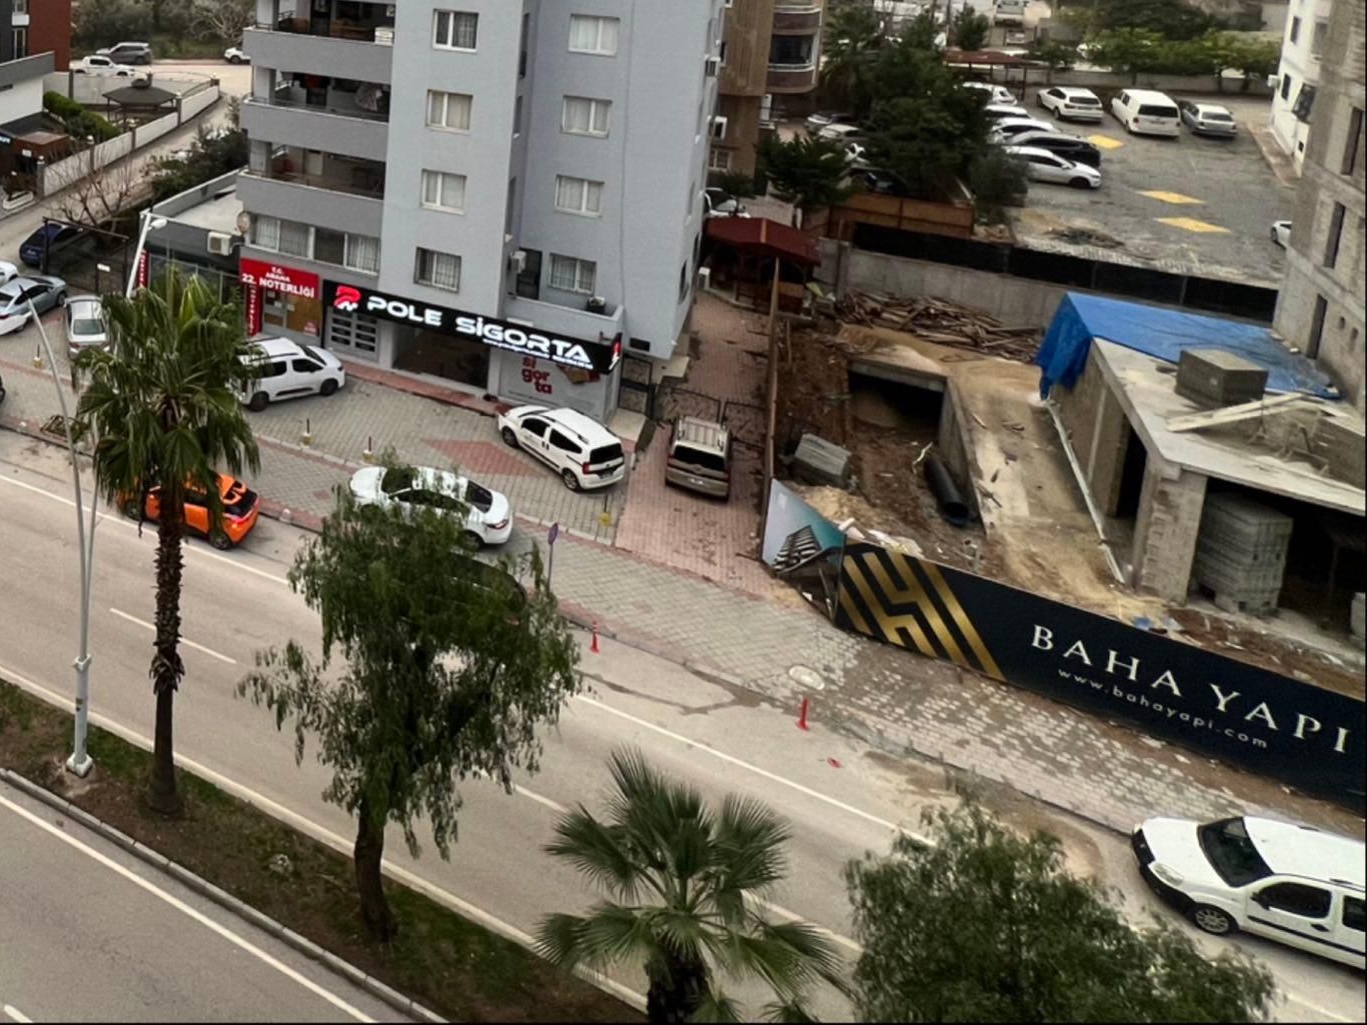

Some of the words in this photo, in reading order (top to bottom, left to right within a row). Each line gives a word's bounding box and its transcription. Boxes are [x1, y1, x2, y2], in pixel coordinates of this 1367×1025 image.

[367, 296, 443, 326] POLE
[1031, 624, 1182, 697] BAHA
[1209, 683, 1353, 753] YAPI
[1058, 668, 1268, 749] www.bahayapi.com
